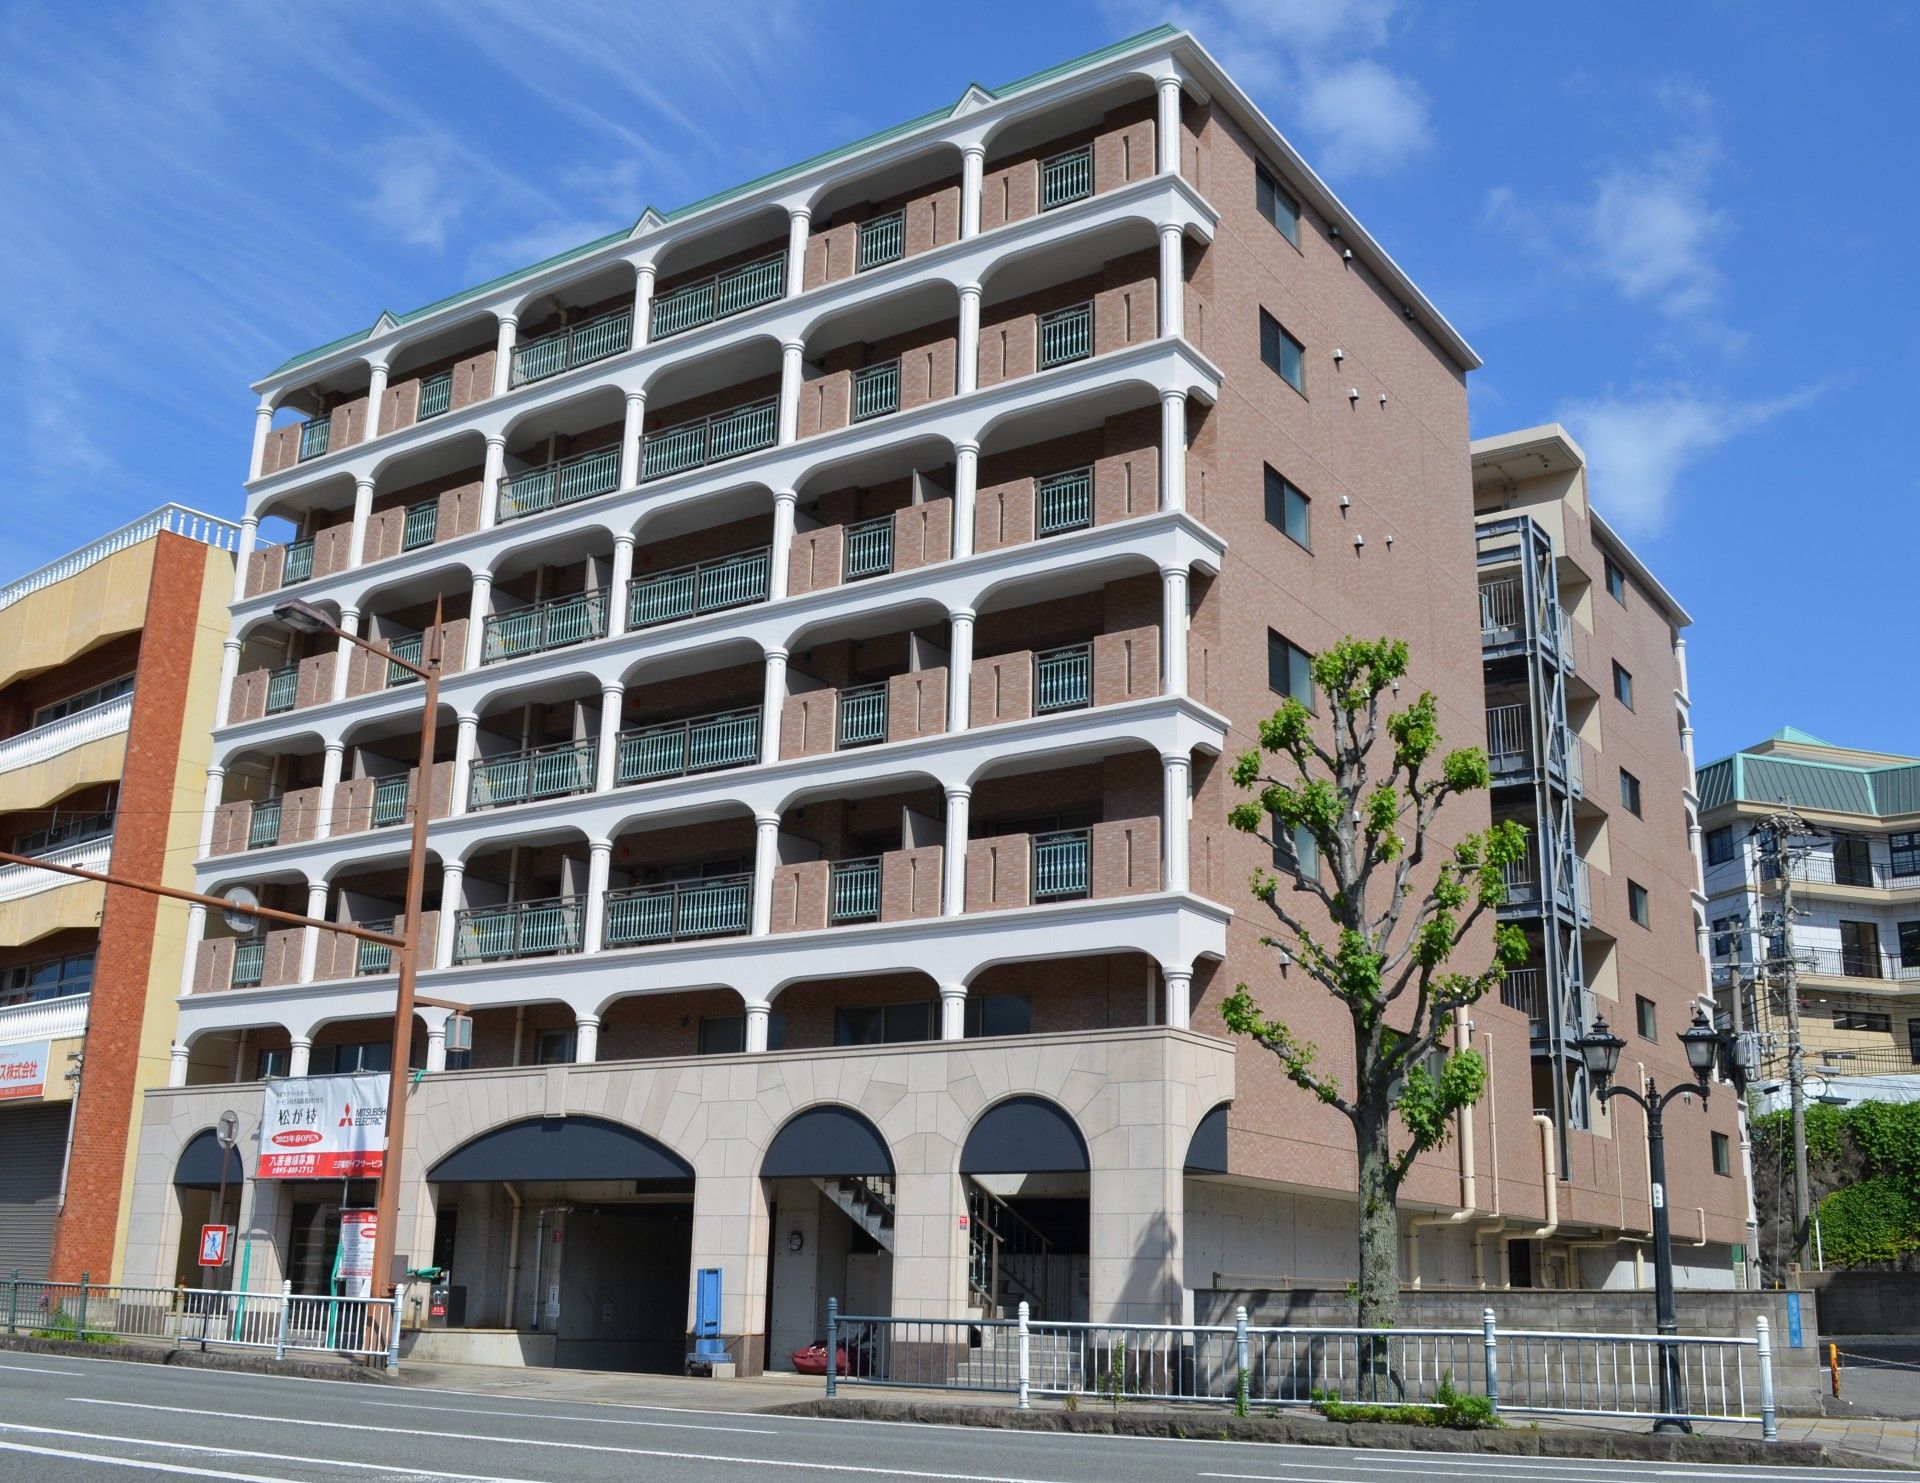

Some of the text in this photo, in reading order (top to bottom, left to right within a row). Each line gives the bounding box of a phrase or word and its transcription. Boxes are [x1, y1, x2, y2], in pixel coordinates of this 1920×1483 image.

[278, 1107, 318, 1126] 松が枝
[355, 1107, 387, 1117] MITSUBISH
[354, 1116, 383, 1126] ELECTRIC
